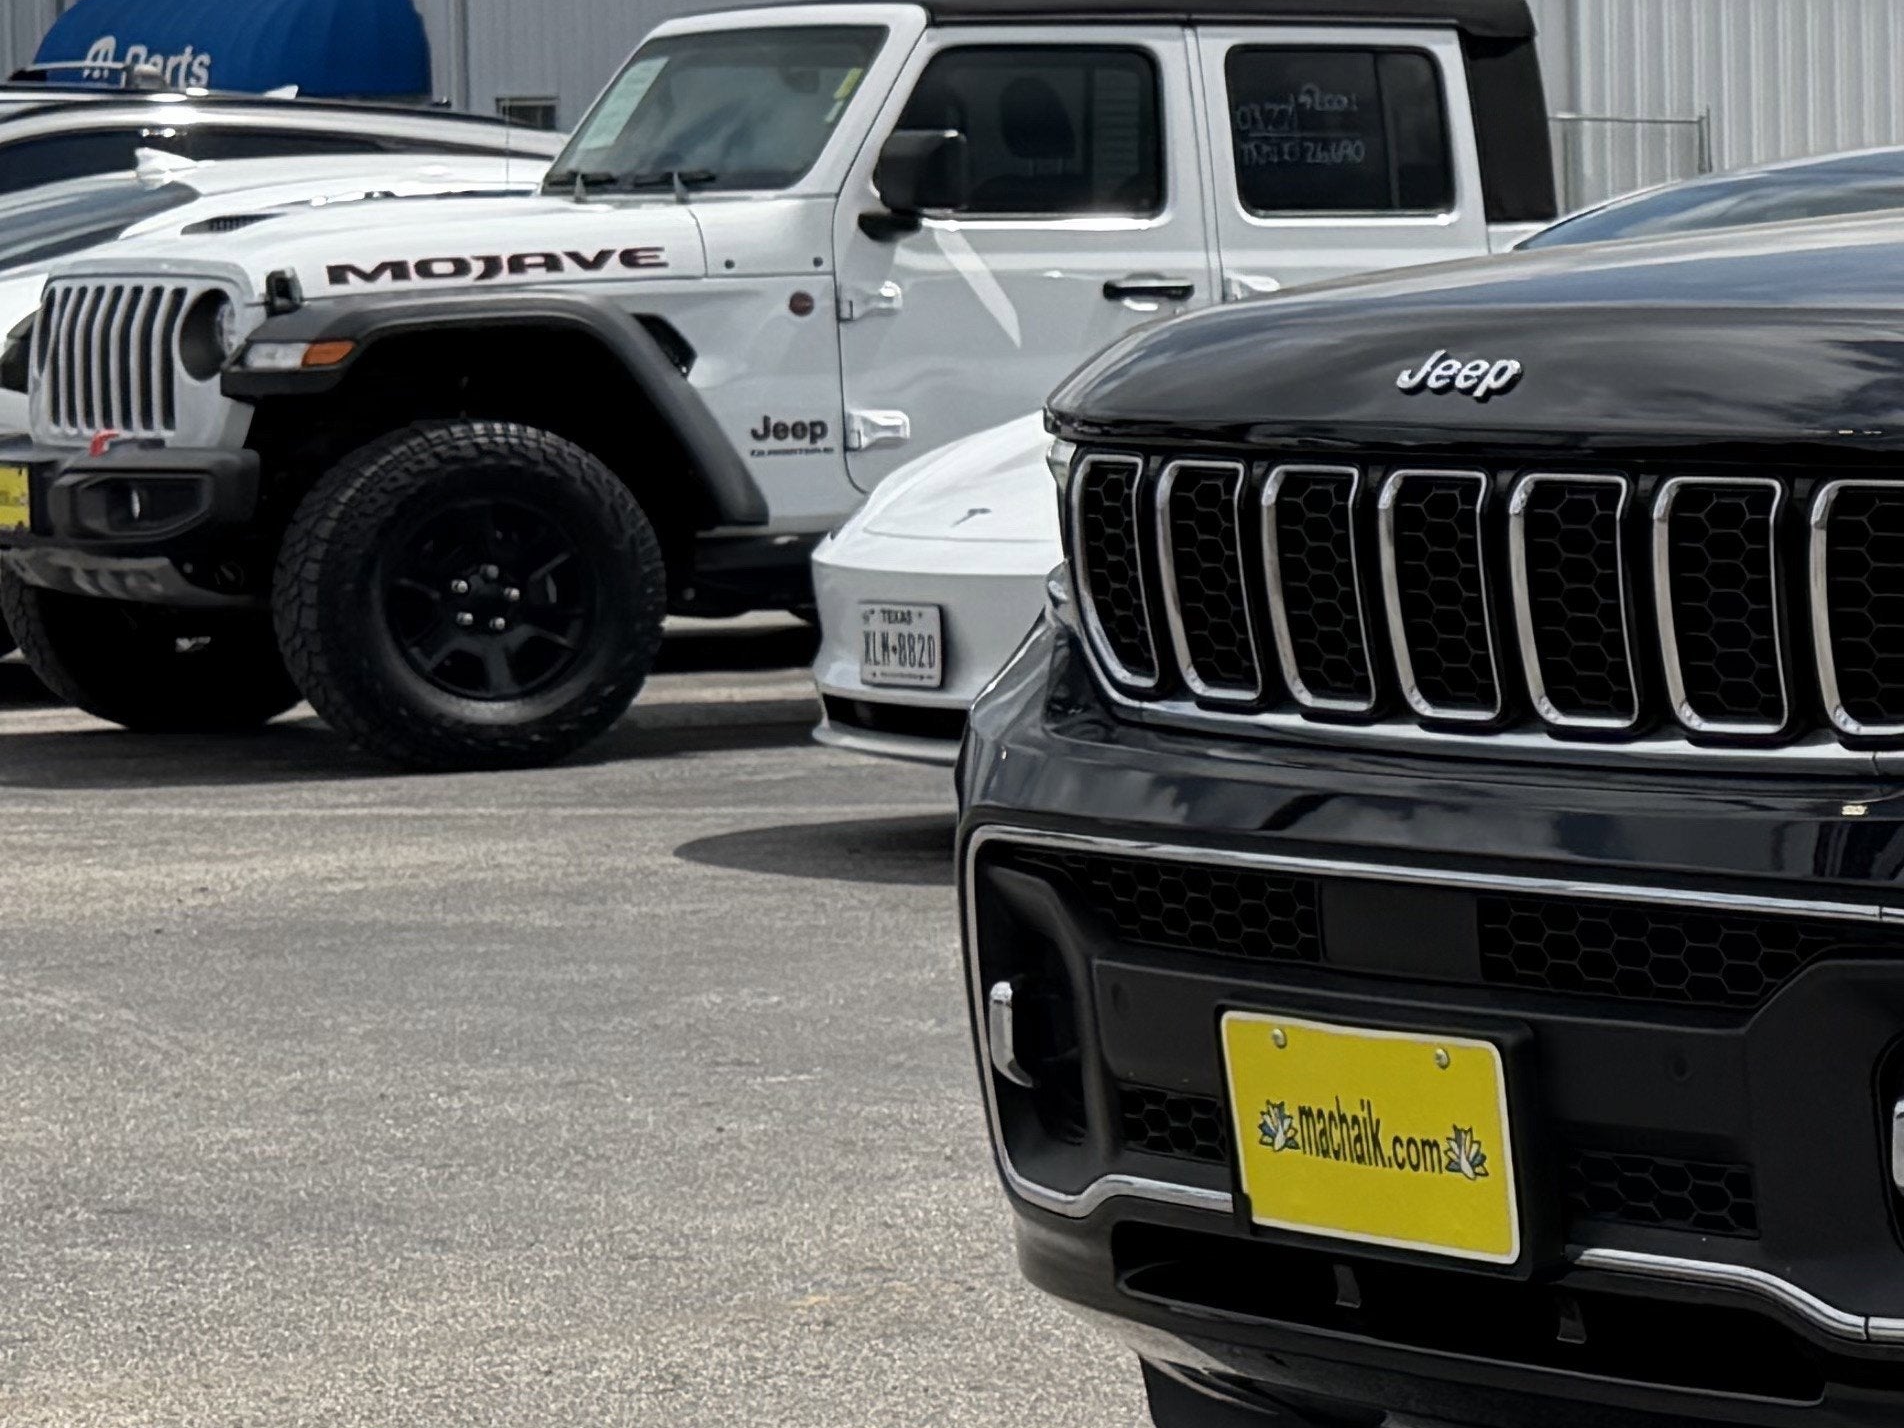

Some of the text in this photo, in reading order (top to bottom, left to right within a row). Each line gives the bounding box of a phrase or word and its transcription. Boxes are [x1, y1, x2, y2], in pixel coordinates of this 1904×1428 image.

[326, 246, 670, 285] MOJAVE
[1396, 348, 1522, 399] Jeep
[750, 415, 829, 445] Jeep
[1298, 1094, 1444, 1174] machaik.com
